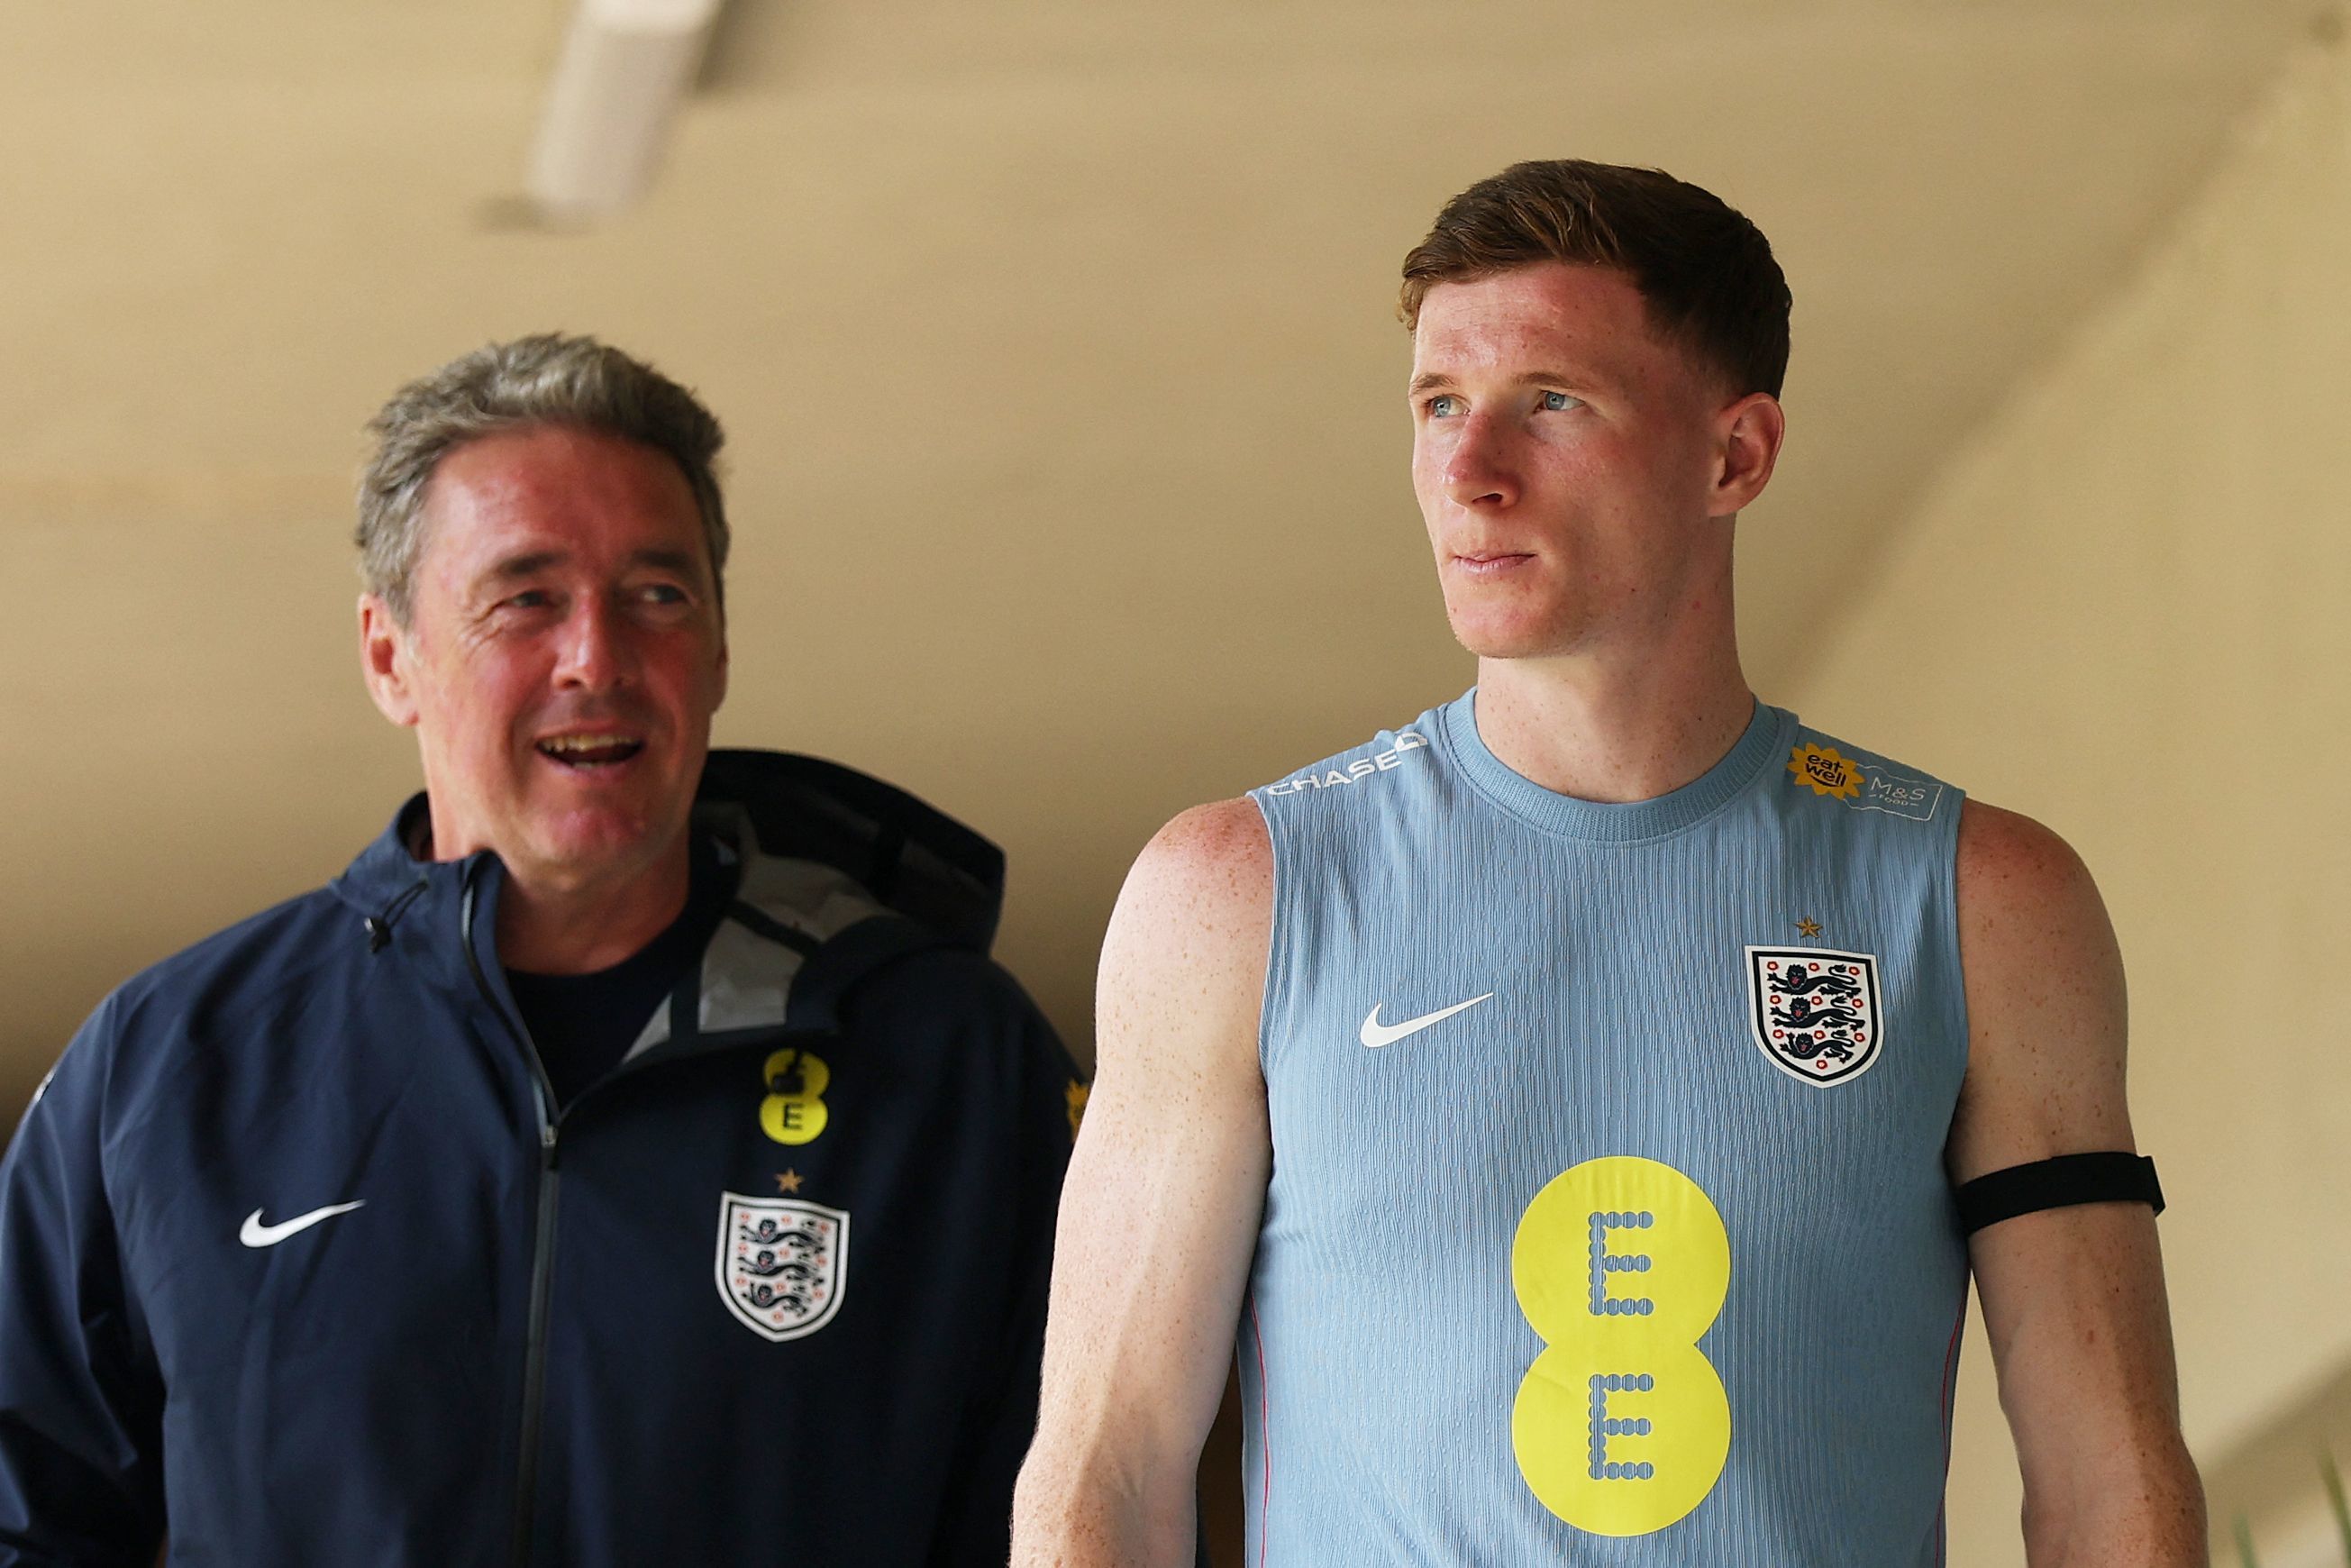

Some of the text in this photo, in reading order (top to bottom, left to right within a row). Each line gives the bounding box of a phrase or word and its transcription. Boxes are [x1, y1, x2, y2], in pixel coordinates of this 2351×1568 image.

[1267, 749, 1402, 796] CHASE
[1805, 762, 1847, 787] well
[1808, 754, 1844, 774] eat
[1870, 777, 1927, 800] M&S
